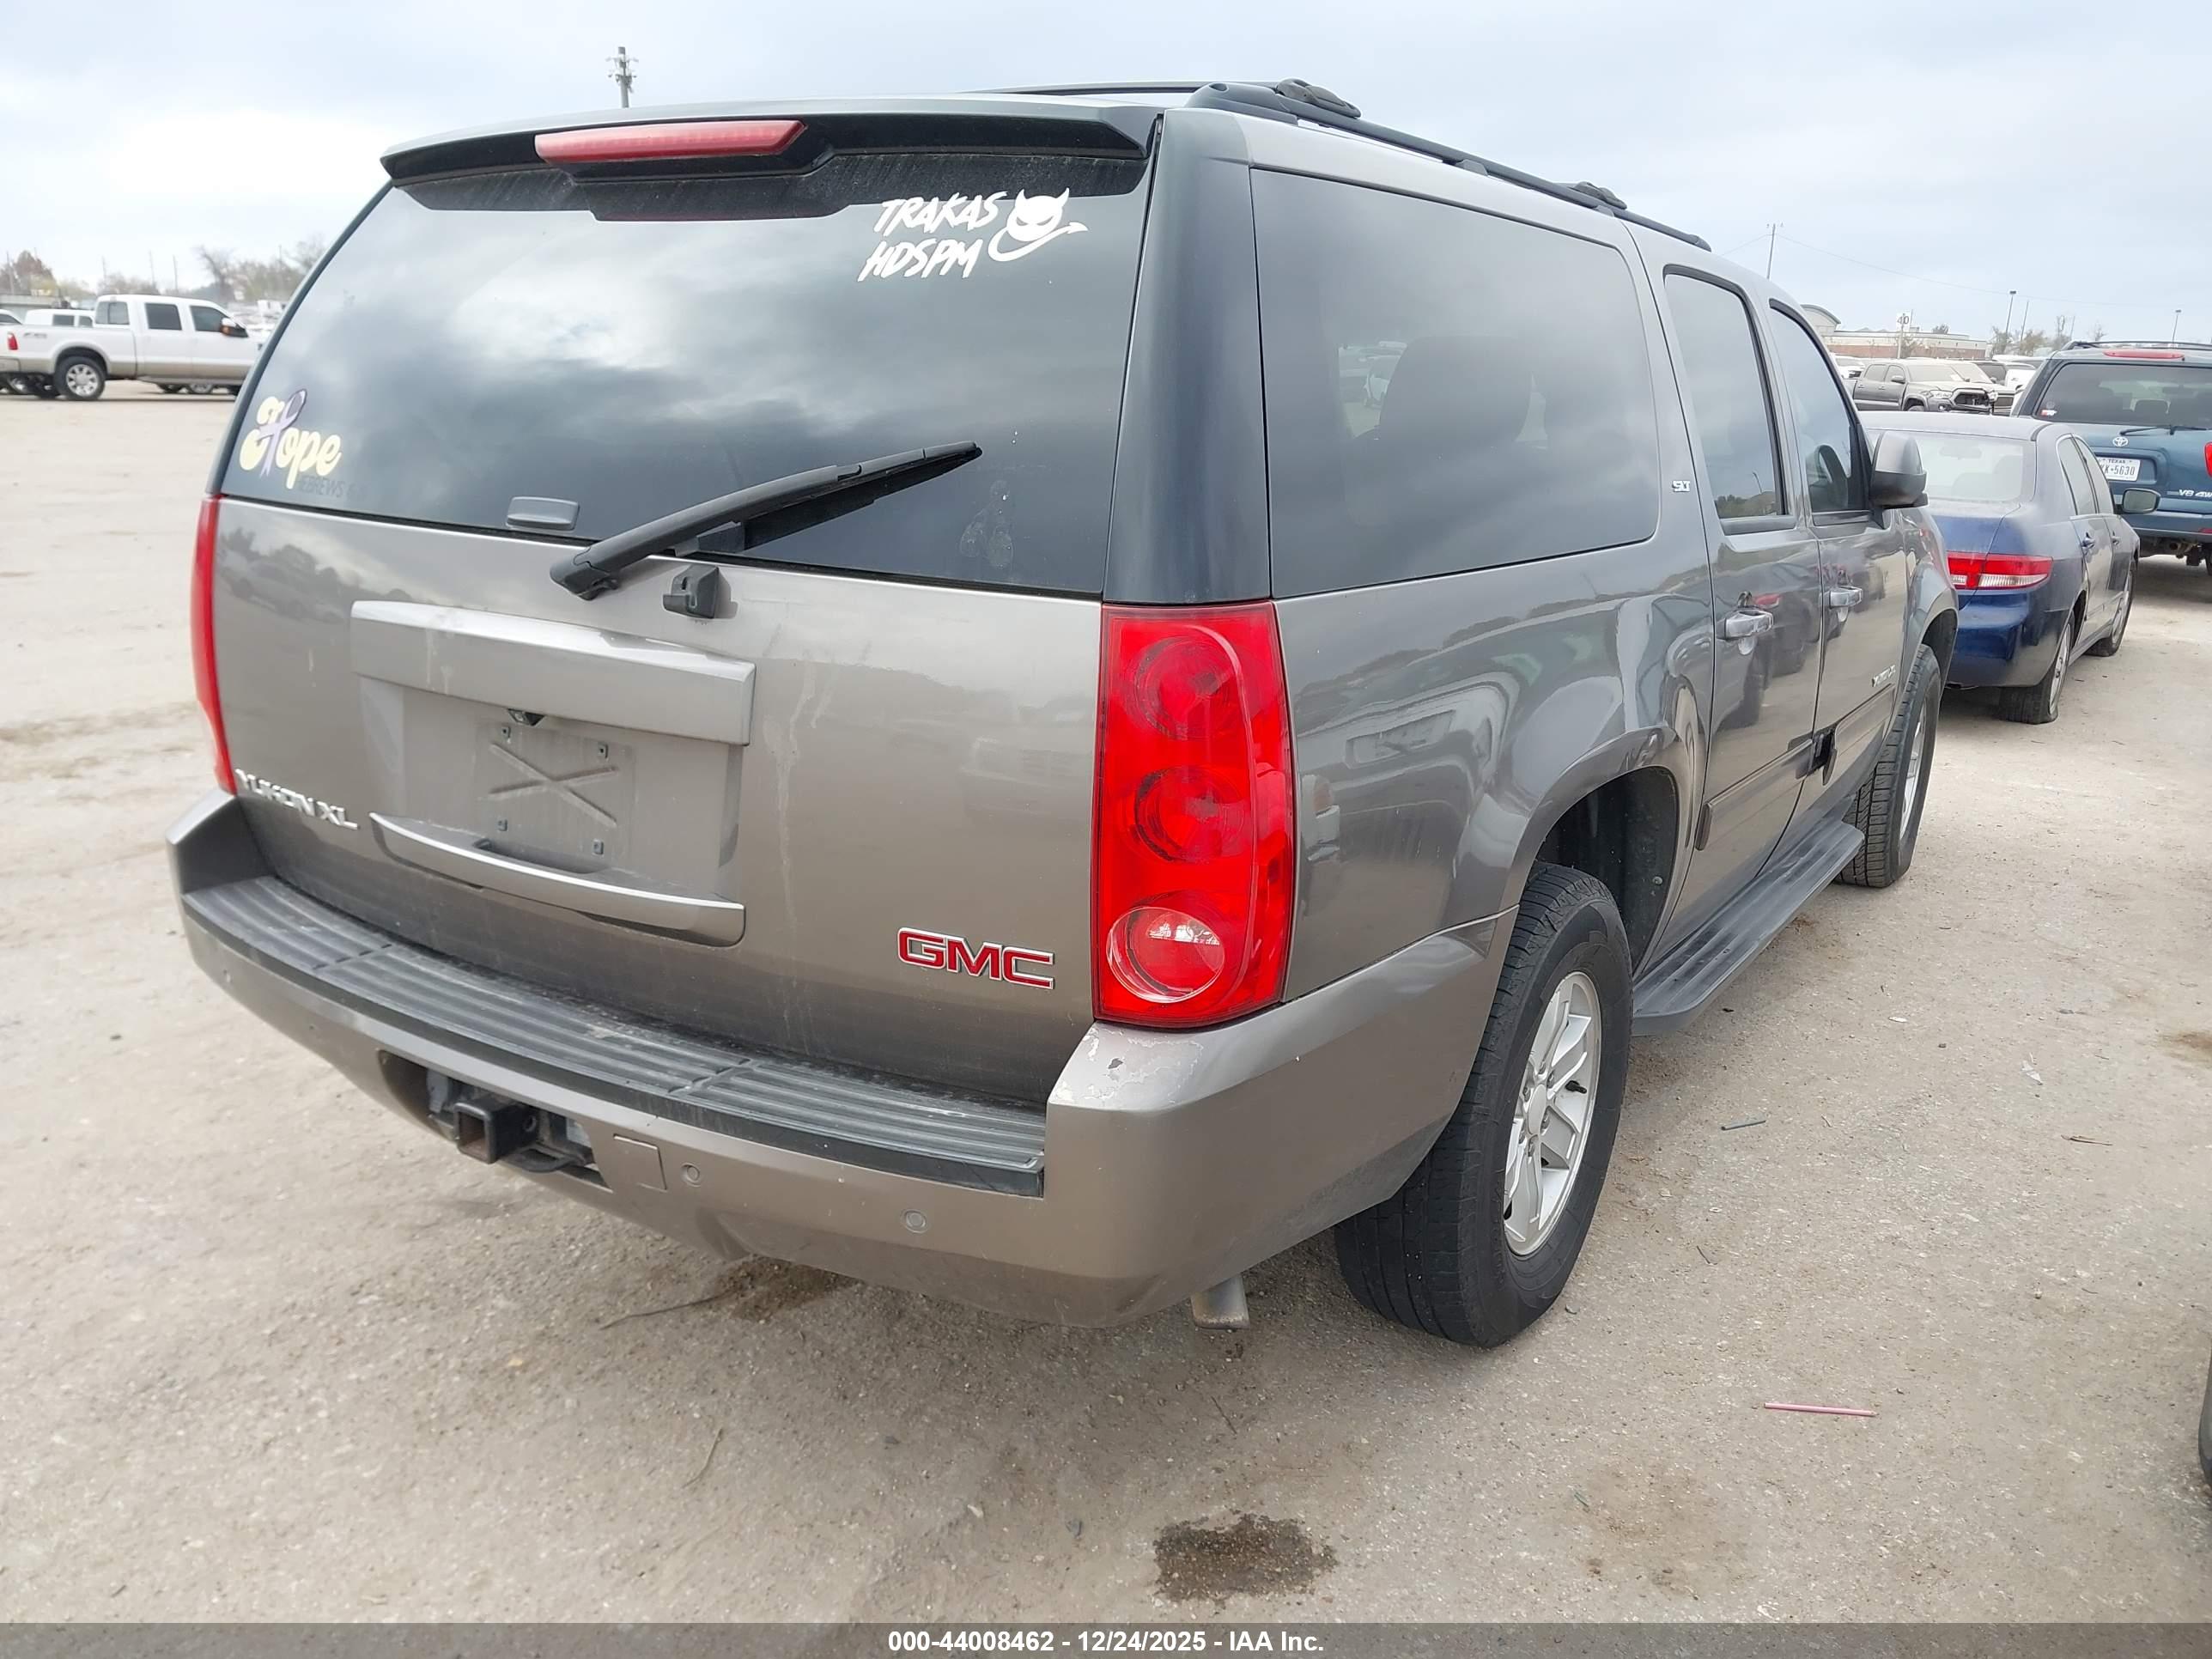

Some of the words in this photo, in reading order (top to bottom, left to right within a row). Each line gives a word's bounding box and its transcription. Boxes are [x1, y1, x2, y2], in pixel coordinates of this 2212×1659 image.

[873, 191, 1008, 236] TRAKAS
[1894, 315, 1910, 325] 40
[240, 392, 342, 489] Hope
[2179, 489, 2195, 497] V8
[317, 801, 358, 830] XL
[897, 927, 1054, 990] GMC
